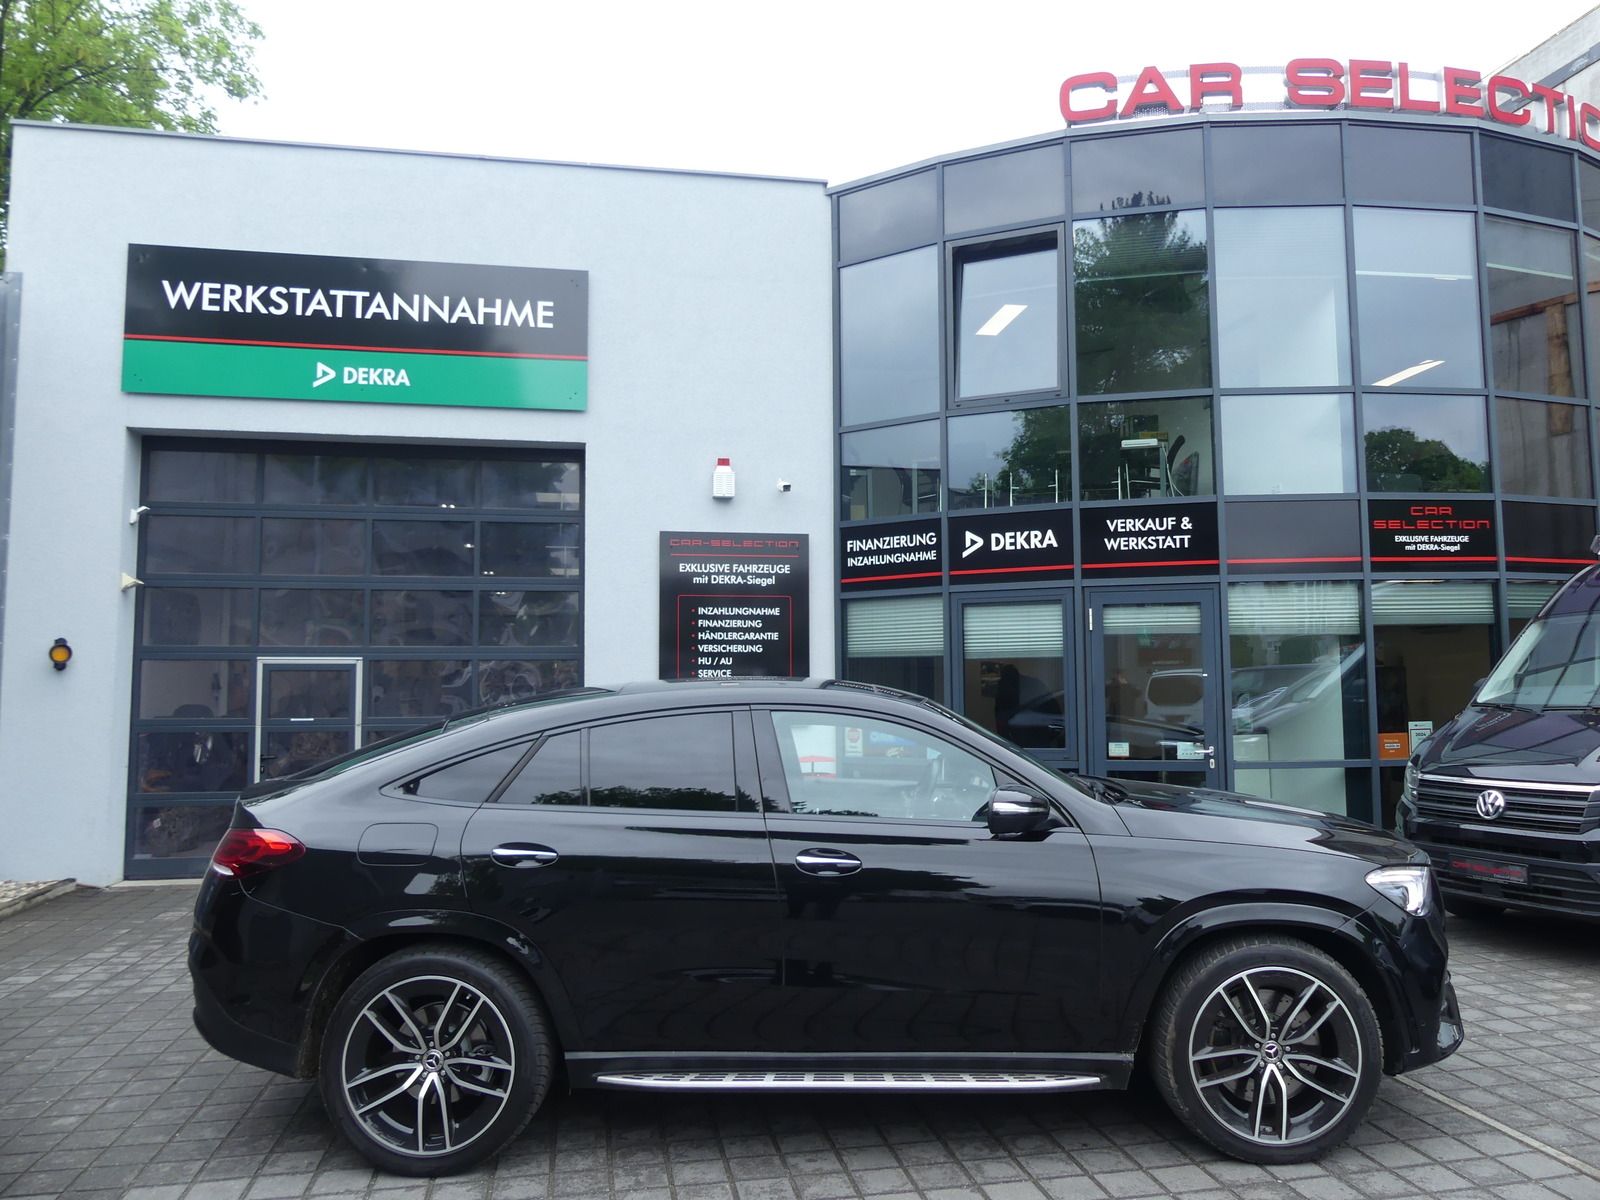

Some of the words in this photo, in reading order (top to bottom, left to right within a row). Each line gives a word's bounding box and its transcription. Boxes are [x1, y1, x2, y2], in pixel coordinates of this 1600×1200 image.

[1060, 62, 1242, 123] CAR
[161, 279, 554, 329] WERKSTATTANNAHME
[342, 366, 411, 387] DEKRA
[1410, 506, 1453, 515] CAR
[1106, 516, 1176, 533] VERKAUF
[1181, 516, 1193, 530] &
[1373, 520, 1490, 529] SELECTION
[846, 532, 937, 553] FINANZIERUNG
[990, 529, 1058, 552] DEKRA
[1104, 534, 1191, 551] WERKSTATT
[1394, 535, 1429, 543] EXKLUSIVE
[1430, 535, 1470, 543] FAHRZEUGE
[1416, 544, 1461, 553] DEKRA-Siegel
[847, 550, 937, 567] INZAHLUNGNAHME
[679, 563, 731, 573] EXKLUSIVE
[732, 564, 791, 574] FAHRZEUGE
[693, 575, 709, 584] mit
[711, 575, 776, 587] DEKRA-Siegel
[698, 607, 780, 616] INZAHLUNGNAHME
[698, 619, 762, 628] FINANZIERUNG
[698, 631, 779, 641] HÄNDLERGARANTIE
[698, 644, 763, 653] VERSICHERUNG
[698, 657, 711, 665] HU
[719, 657, 733, 665] AU
[698, 669, 732, 678] SERVICE
